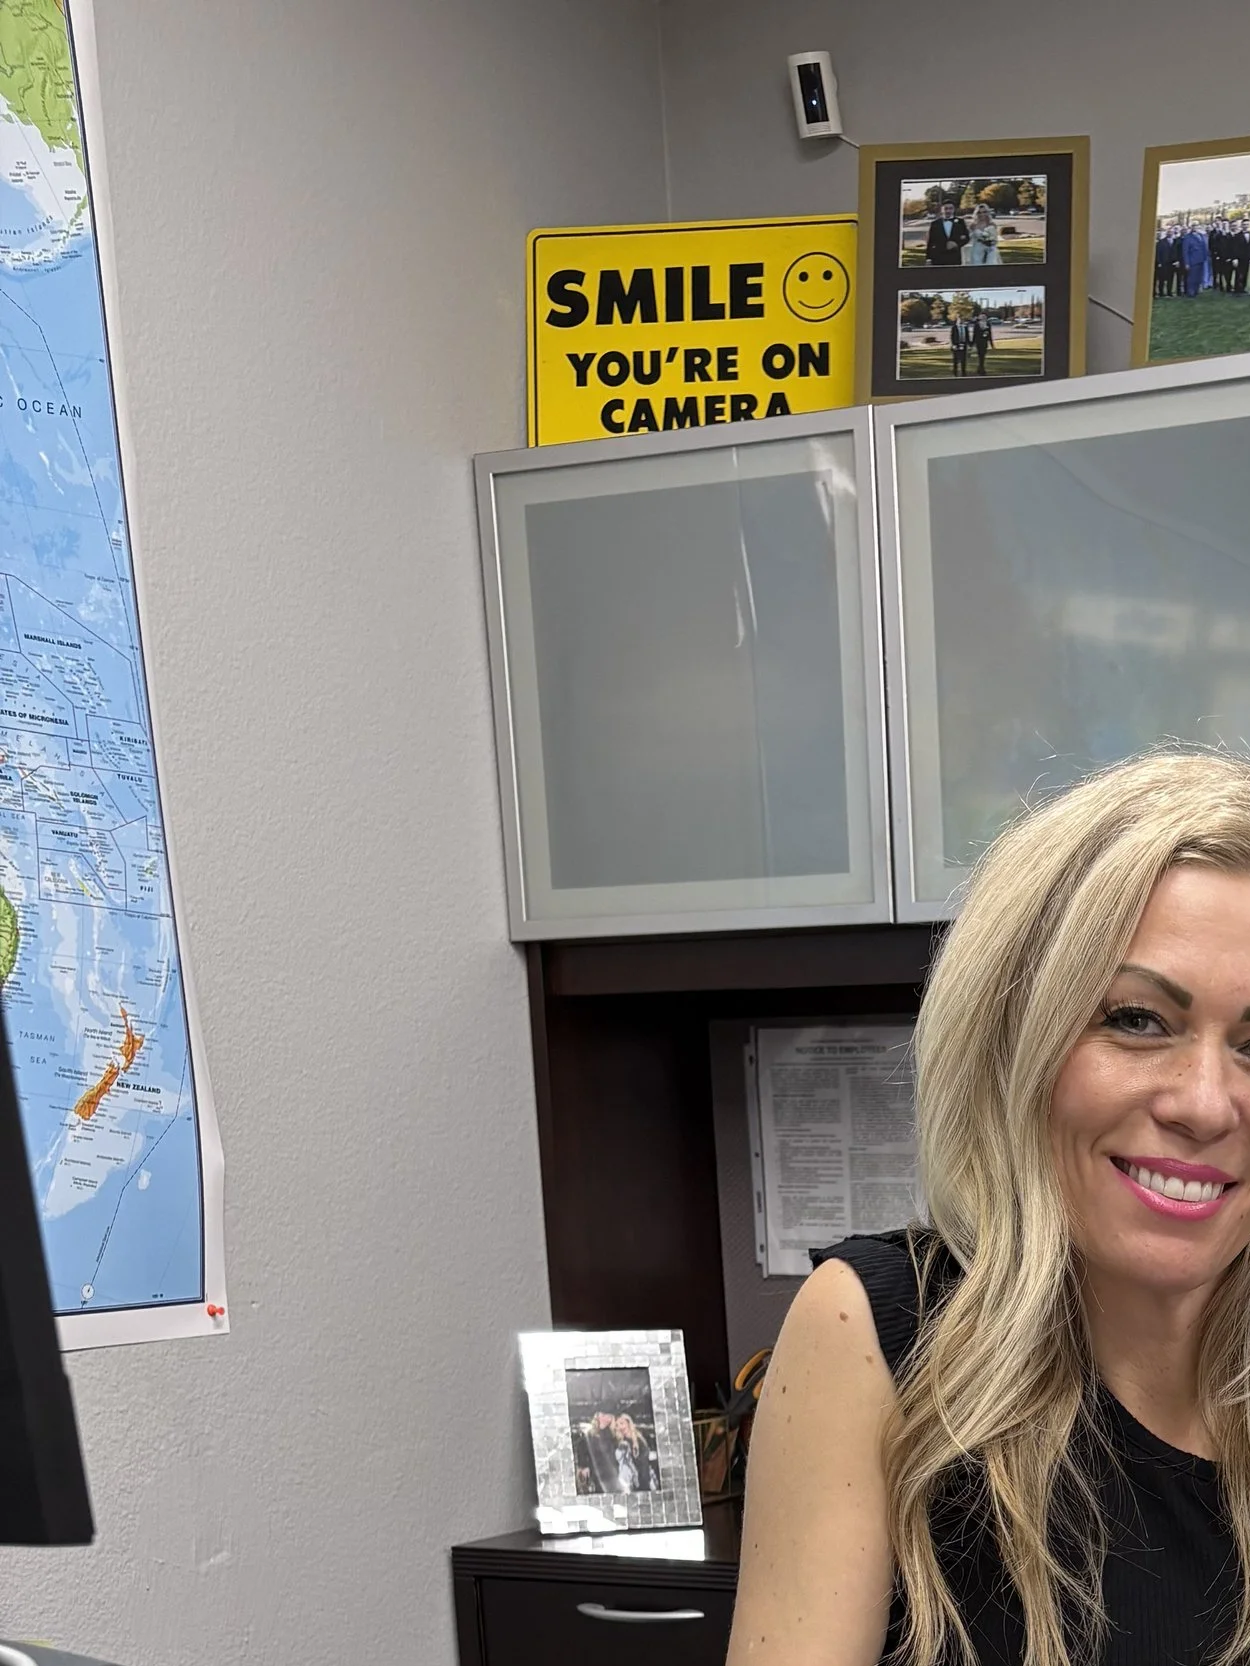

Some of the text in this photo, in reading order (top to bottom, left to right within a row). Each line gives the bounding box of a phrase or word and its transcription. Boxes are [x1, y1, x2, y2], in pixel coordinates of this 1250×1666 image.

[545, 262, 764, 329] SMILE
[566, 341, 830, 388] YOU'RE ON
[17, 397, 82, 419] OCEAN
[600, 391, 792, 434] CAMERA
[18, 1030, 56, 1043] TASMAN
[30, 1056, 47, 1065] SEA
[116, 1080, 161, 1095] NEW ZEALAND
